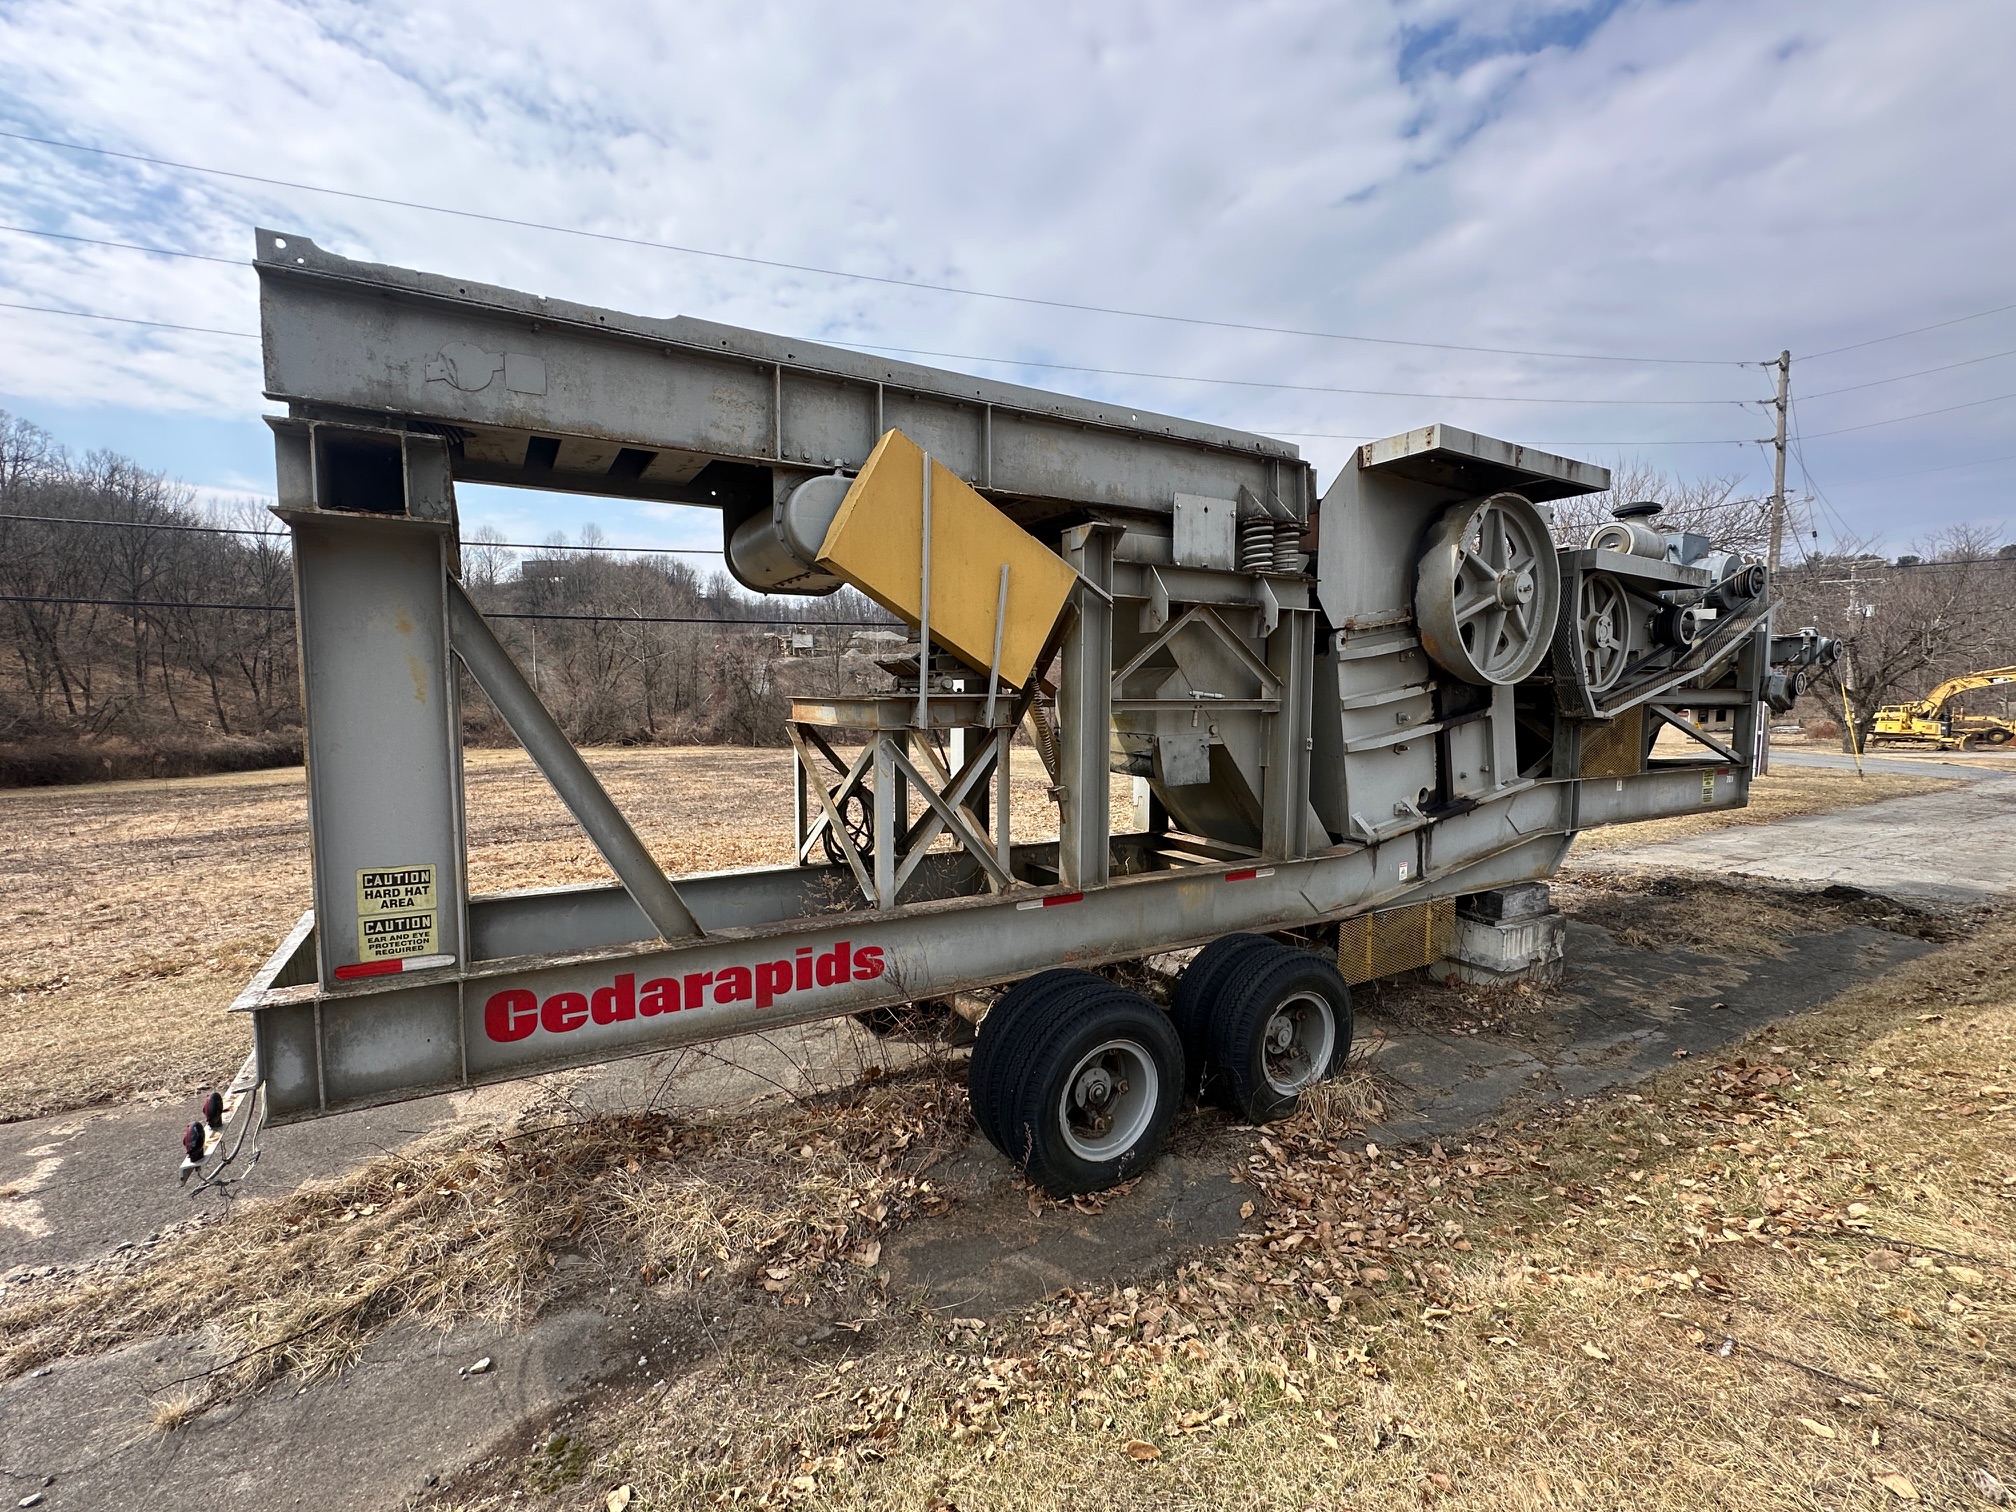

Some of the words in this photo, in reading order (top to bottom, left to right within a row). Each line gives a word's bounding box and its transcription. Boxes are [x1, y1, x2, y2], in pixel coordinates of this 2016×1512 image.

[364, 871, 430, 887] CAUTION
[365, 888, 400, 899] HARD
[405, 886, 430, 896] HAT
[380, 898, 415, 909] AREA
[365, 916, 431, 933] CAUTION
[367, 936, 387, 944] EAR
[389, 933, 409, 941] AND
[412, 931, 430, 939] EYE
[368, 938, 430, 950] PROTECTION
[375, 945, 424, 956] REQUIRED
[484, 941, 886, 1043] Cedarapids
